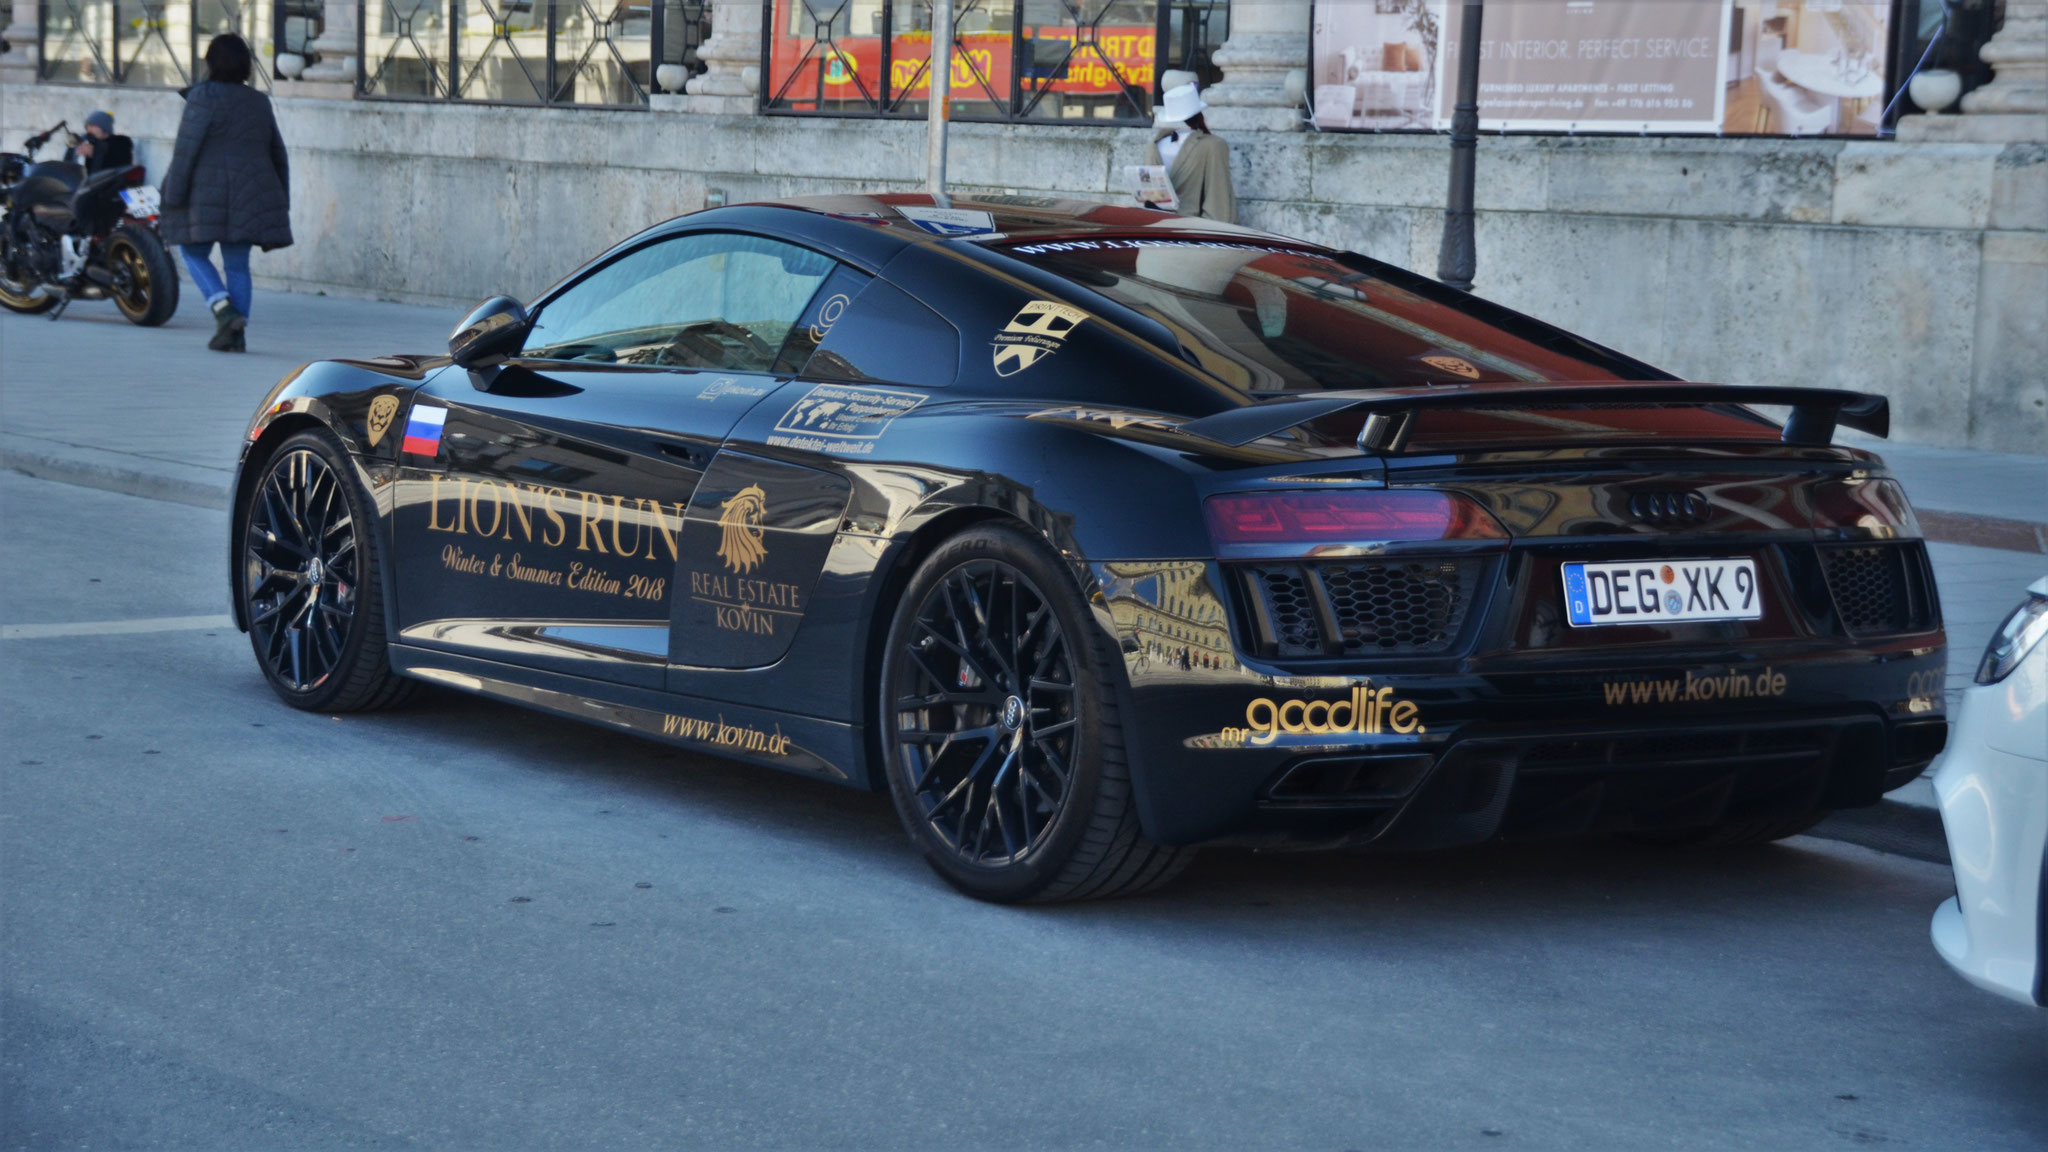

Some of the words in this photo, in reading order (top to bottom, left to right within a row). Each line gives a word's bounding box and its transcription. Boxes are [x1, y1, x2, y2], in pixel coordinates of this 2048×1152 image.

[1577, 39, 1640, 60] PERFECT
[766, 436, 875, 454] www.detektei-weltweit.de
[577, 491, 685, 563] RUN
[442, 544, 486, 577] Winter
[490, 553, 502, 577] &
[506, 552, 562, 587] Summer
[567, 561, 621, 596] Edition
[624, 574, 666, 601] 2018
[692, 571, 732, 598] REAL
[738, 578, 800, 608] ESTATE
[1575, 600, 1585, 614] D
[1586, 569, 1661, 616] DEG
[1682, 566, 1730, 612] XK
[1734, 565, 1755, 610] 9
[716, 606, 773, 635] KOVIN
[1603, 666, 1787, 705] www.kovin.de
[663, 713, 791, 756] www.kovin.de
